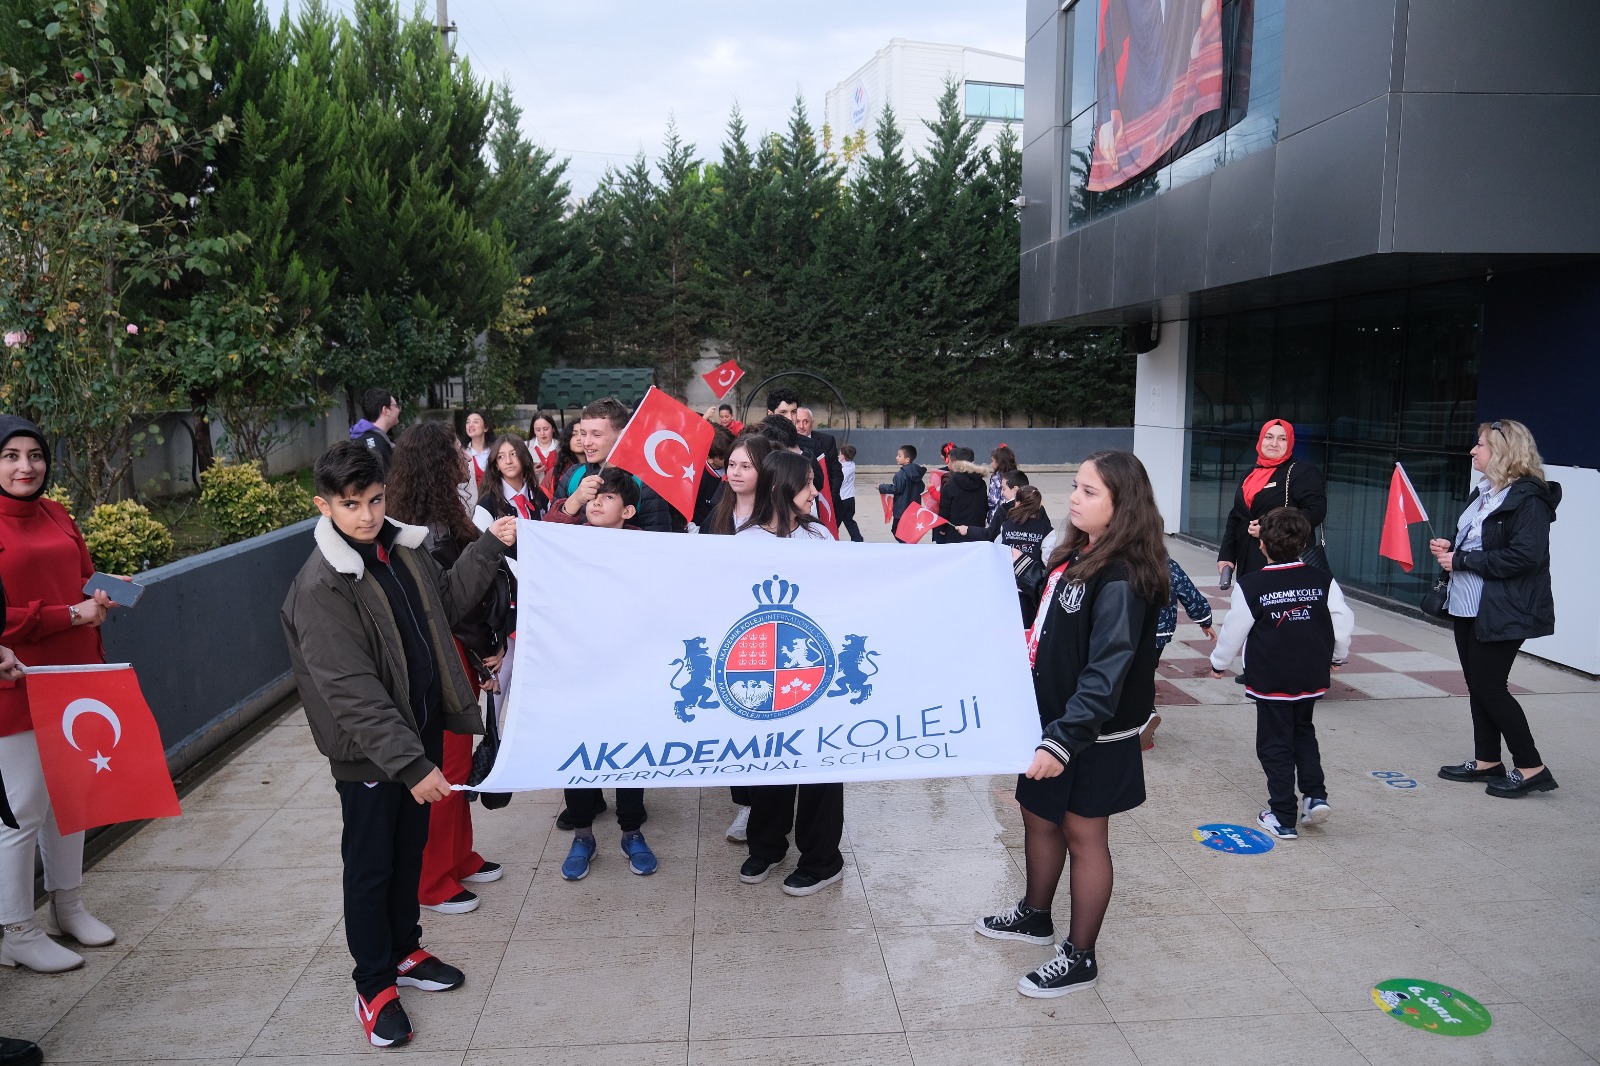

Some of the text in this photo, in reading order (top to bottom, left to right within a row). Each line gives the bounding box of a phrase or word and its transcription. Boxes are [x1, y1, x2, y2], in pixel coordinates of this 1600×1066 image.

[1271, 609, 1309, 619] NASA
[568, 743, 958, 785] INTERNATIONAL SCHOOL
[397, 958, 417, 972] NIKE
